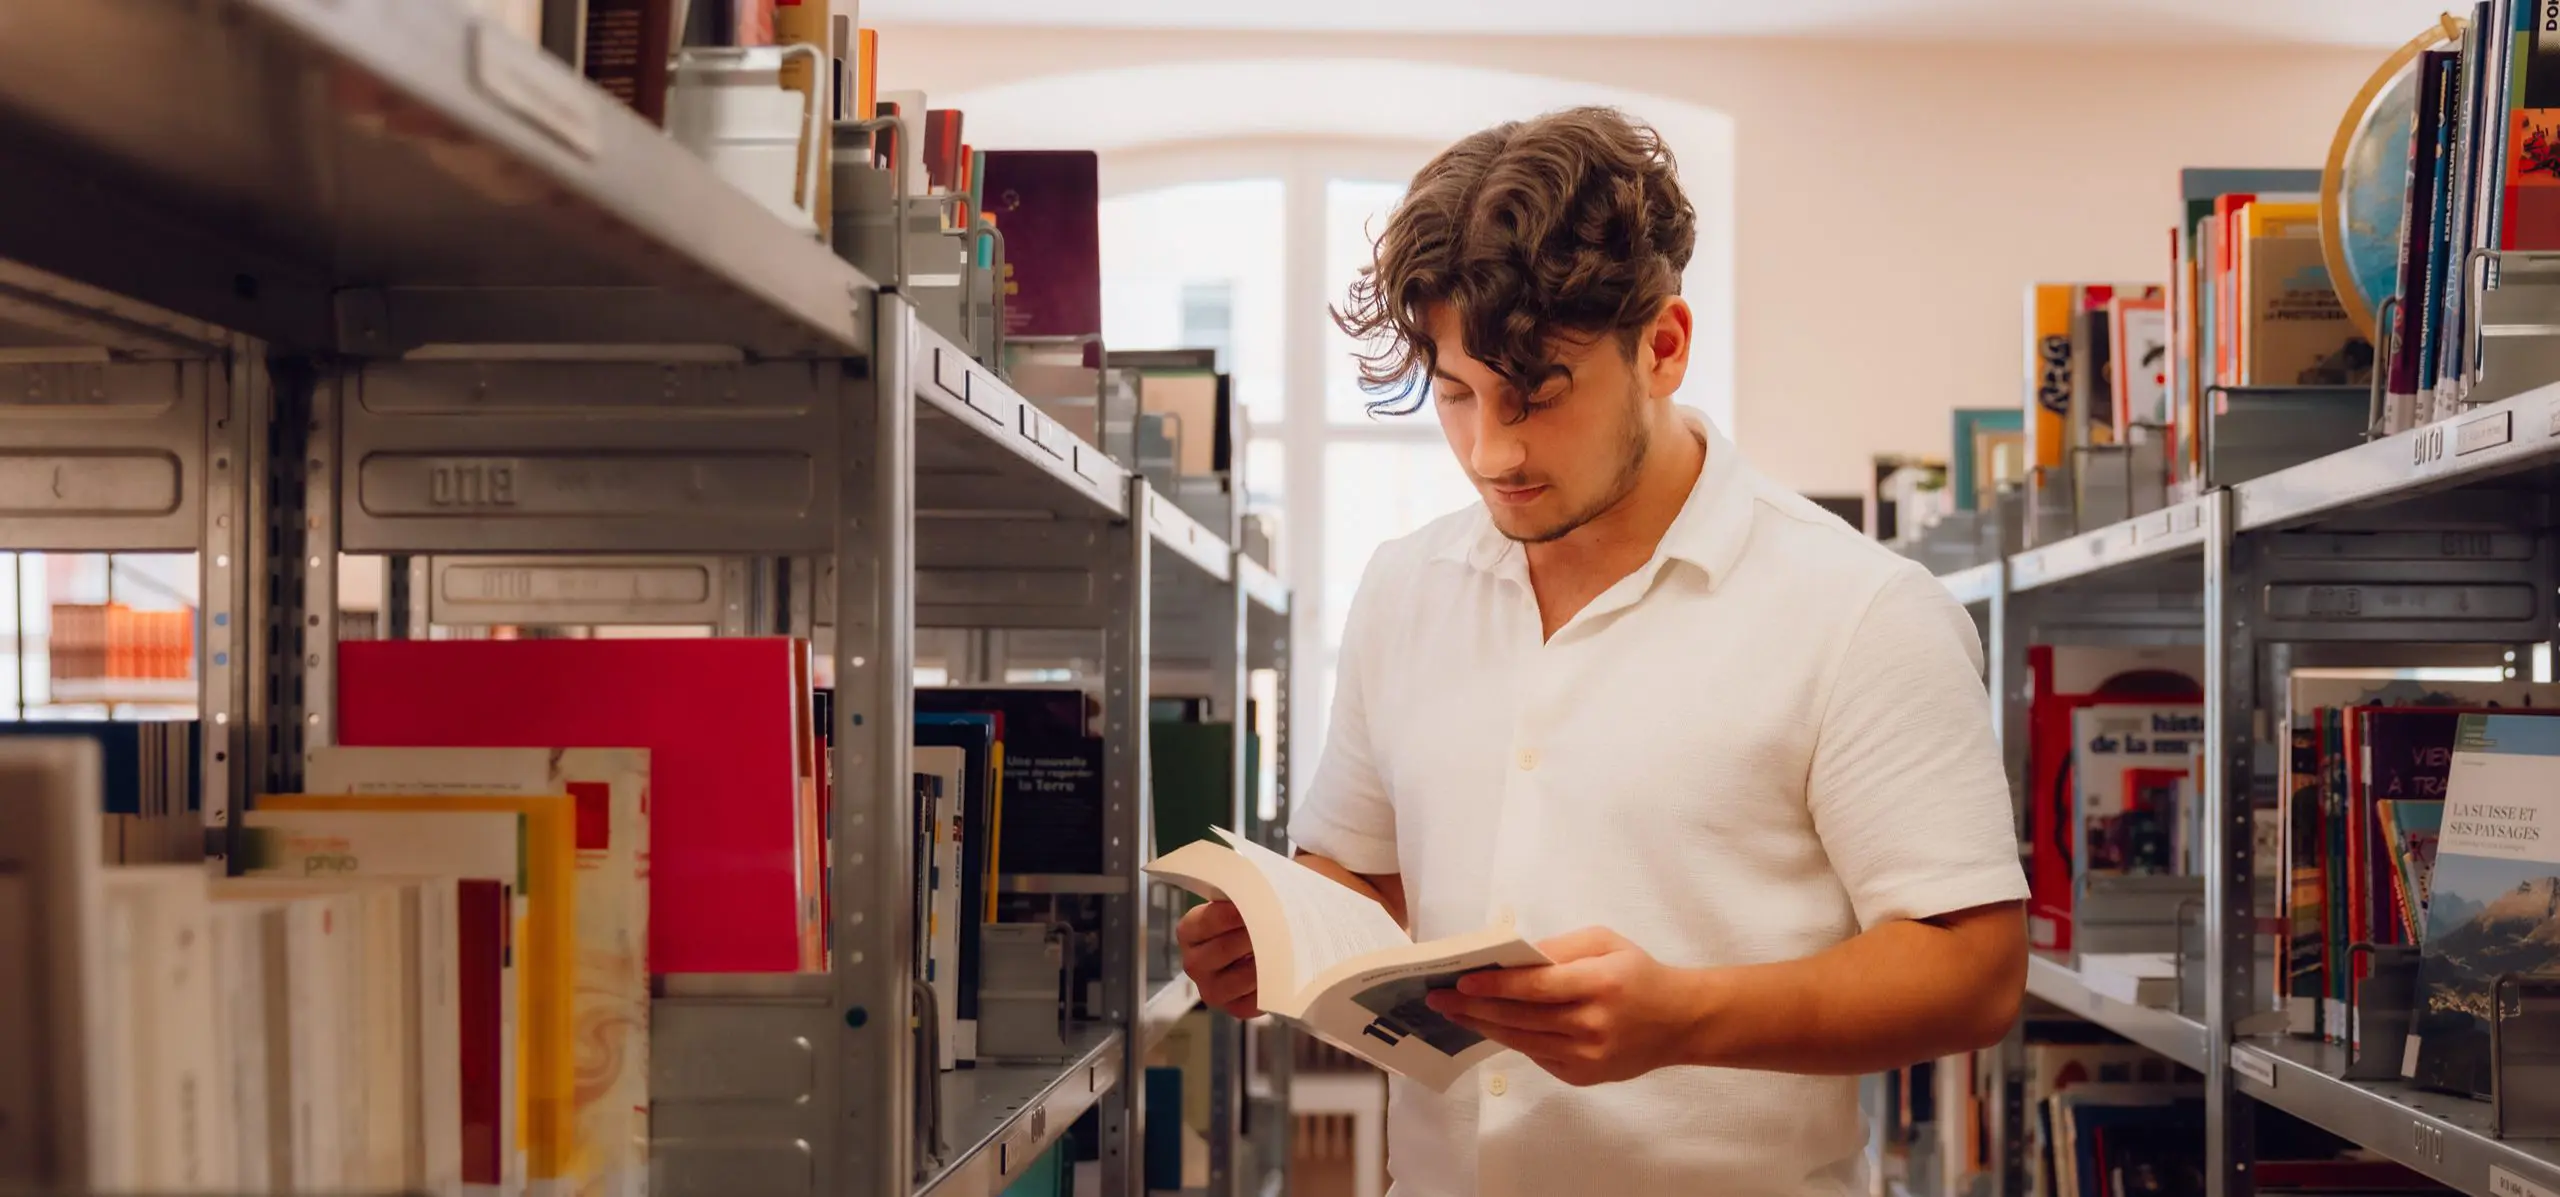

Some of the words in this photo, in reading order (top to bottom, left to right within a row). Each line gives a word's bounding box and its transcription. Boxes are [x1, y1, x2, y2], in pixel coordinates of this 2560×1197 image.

[2443, 142, 2457, 242] EXPLORATEURS
[2090, 733, 2117, 753] de
[2125, 733, 2147, 753] la
[1006, 755, 1032, 767] Une
[1018, 779, 1032, 791] la
[1036, 779, 1076, 792] Terre
[2453, 802, 2469, 817] LA
[2470, 803, 2517, 821] SUISSE
[2519, 806, 2538, 822] ET
[2449, 821, 2473, 836] SES
[2474, 822, 2541, 841] PAYSAGES
